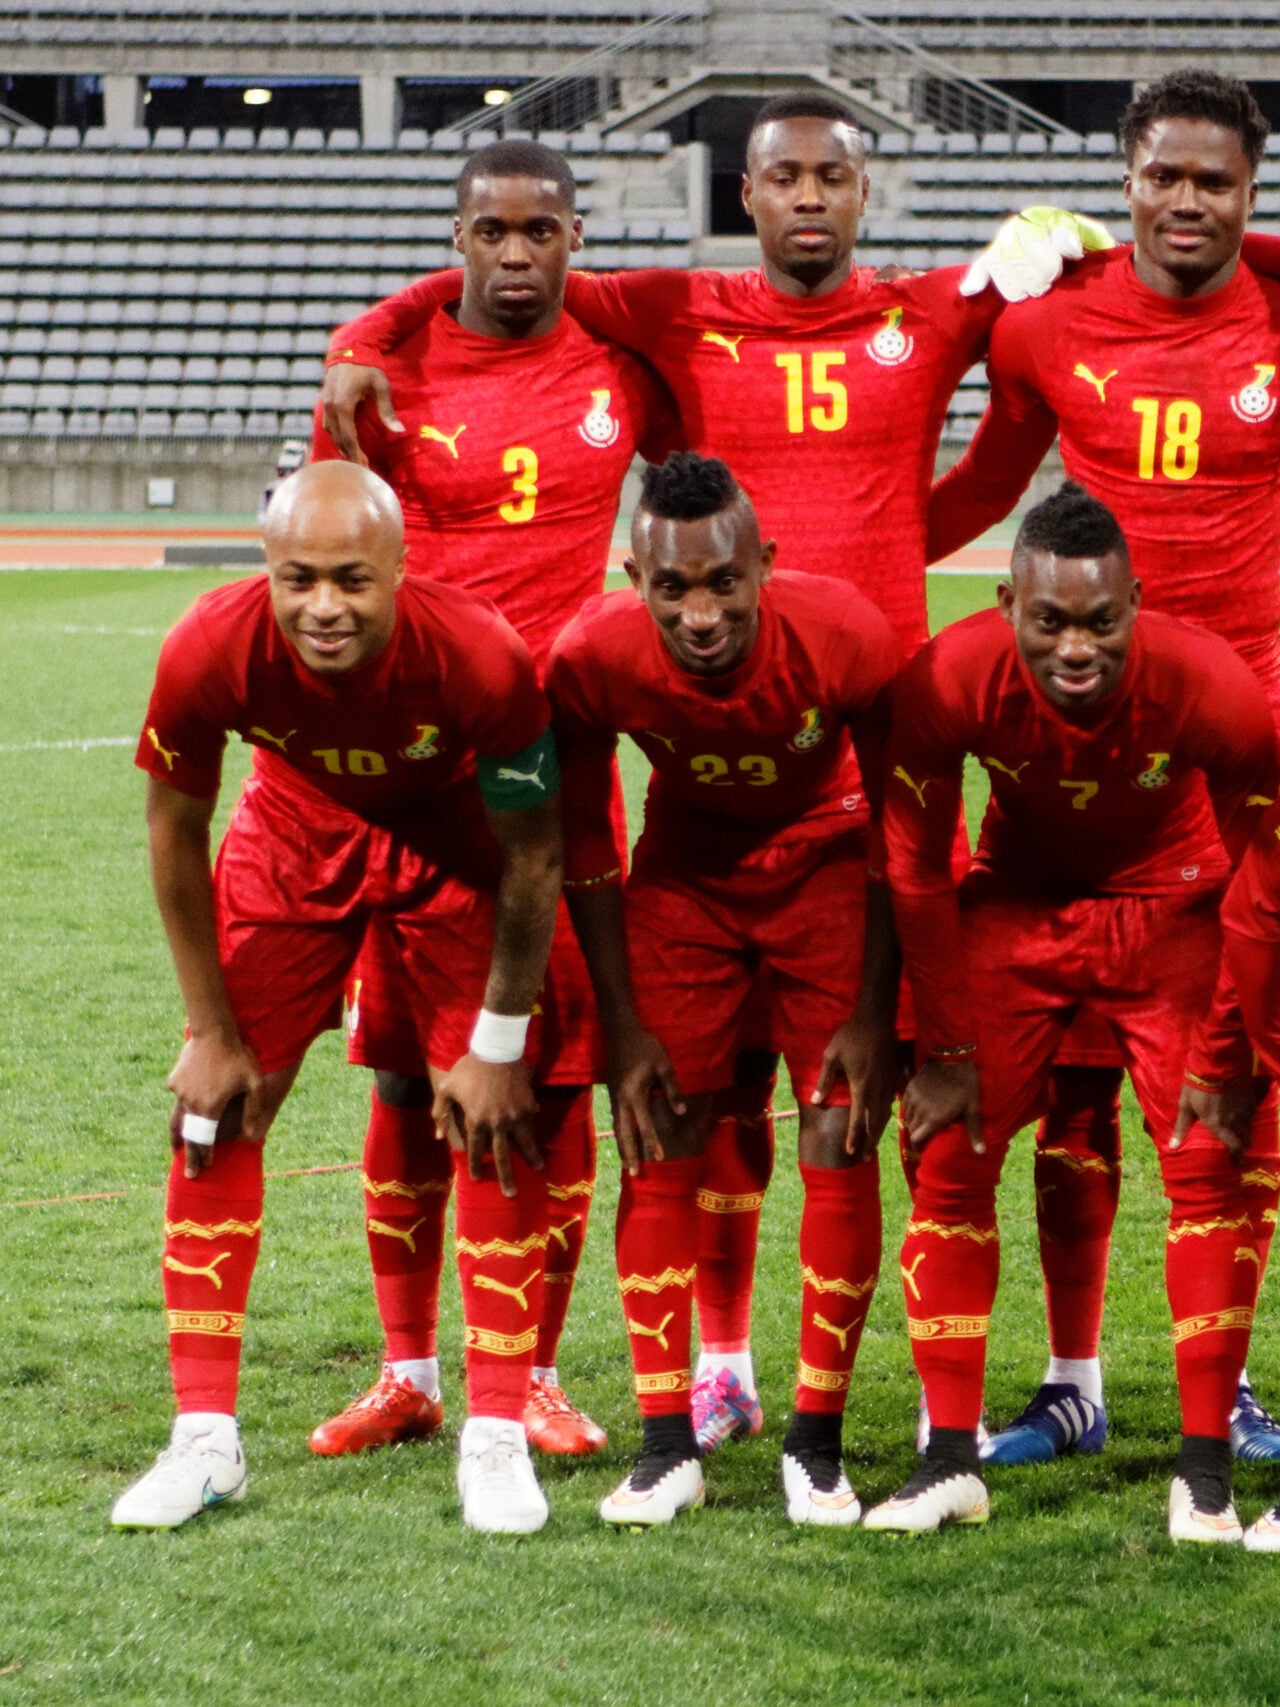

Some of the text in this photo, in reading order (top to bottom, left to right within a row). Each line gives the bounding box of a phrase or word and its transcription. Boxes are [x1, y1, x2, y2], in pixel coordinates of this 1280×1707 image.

[775, 352, 848, 433] 15
[1132, 399, 1201, 481] 18
[499, 449, 538, 524] 3
[313, 749, 387, 776] 10
[691, 754, 778, 786] 23
[1060, 781, 1098, 809] 7
